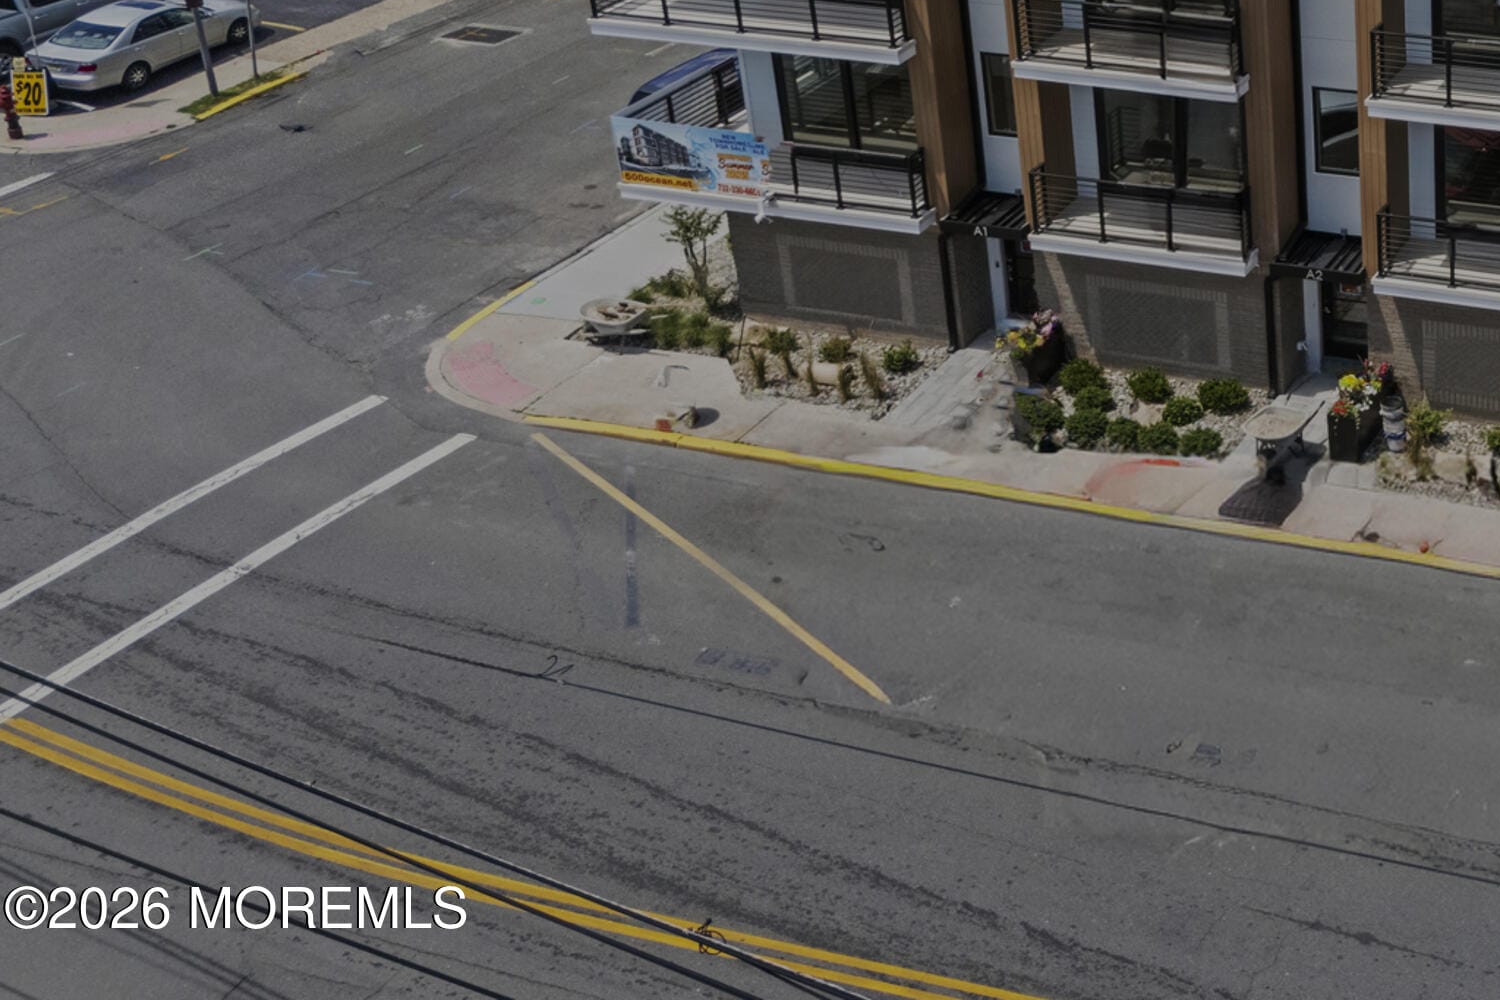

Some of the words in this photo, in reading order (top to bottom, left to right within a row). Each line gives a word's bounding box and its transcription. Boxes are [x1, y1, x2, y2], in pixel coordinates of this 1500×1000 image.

[16, 80, 42, 106] $20
[624, 172, 694, 188] 500ocean.net
[973, 226, 988, 237] A1
[1305, 269, 1324, 281] A2
